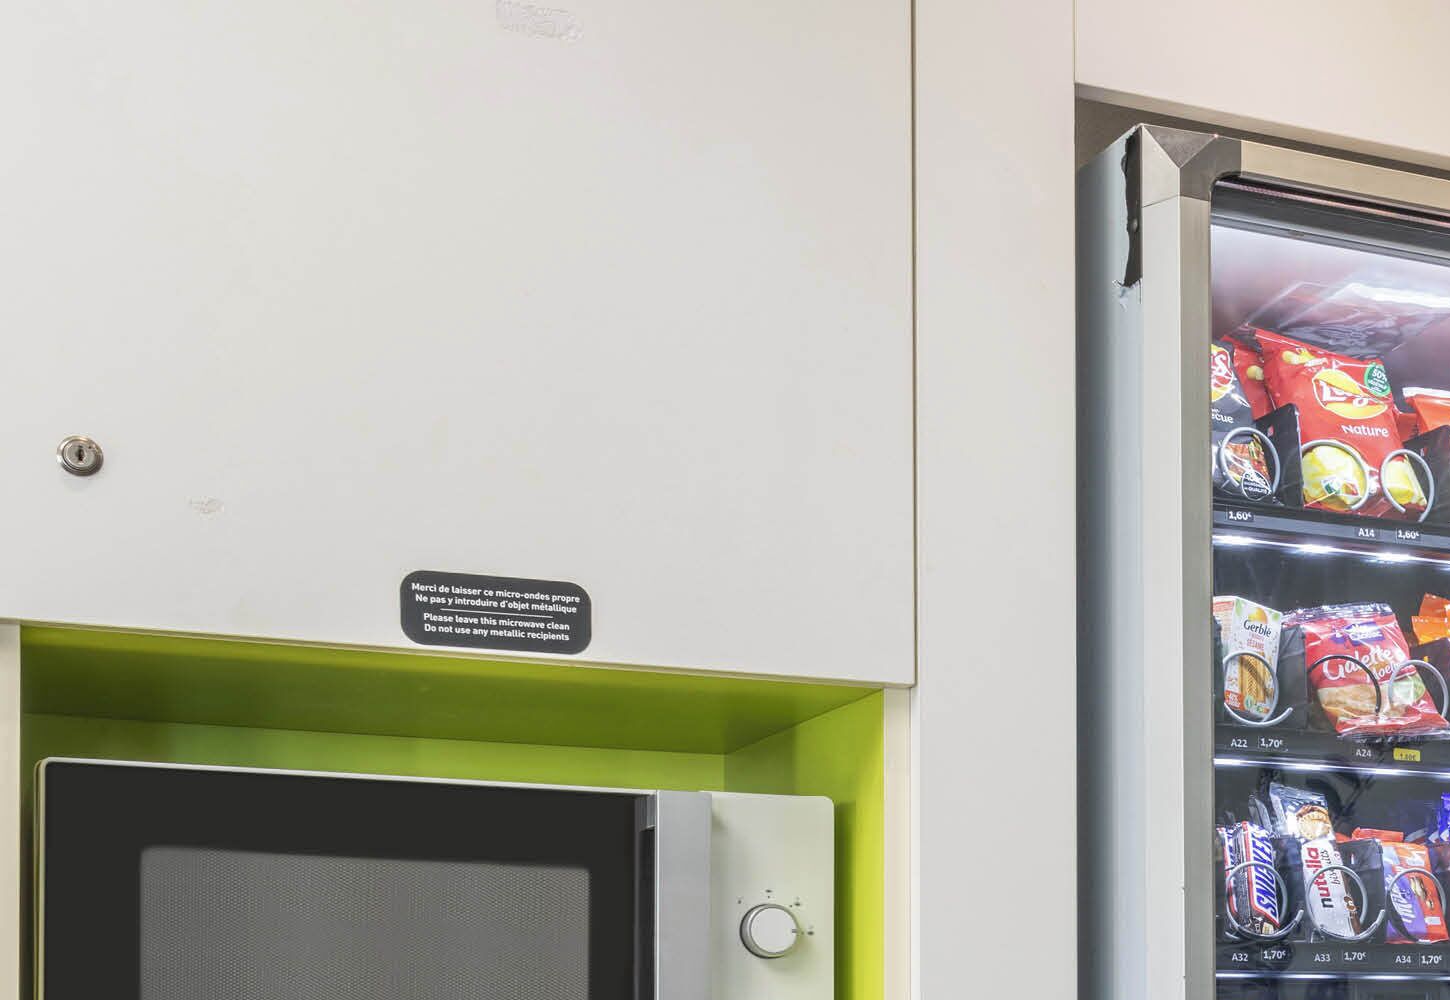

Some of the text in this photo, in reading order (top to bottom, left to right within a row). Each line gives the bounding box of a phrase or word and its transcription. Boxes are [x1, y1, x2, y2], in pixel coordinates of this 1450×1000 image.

[1341, 424, 1389, 438] Nature
[1358, 528, 1375, 538] A14
[411, 582, 580, 603] Merci de laisser ce micro-ondes propre
[415, 594, 428, 602] Ne
[430, 597, 446, 605] pas
[455, 596, 498, 608] introduire
[500, 600, 530, 611] d'objet
[531, 602, 577, 613] métallique
[423, 612, 570, 631] Please leave this microwave clean
[424, 623, 570, 641] Do not use any metallic recipients
[1230, 738, 1248, 748] A22
[1355, 748, 1372, 758] A24
[1231, 952, 1249, 962] A32
[1314, 953, 1331, 963] A33
[1395, 955, 1411, 964] A34
